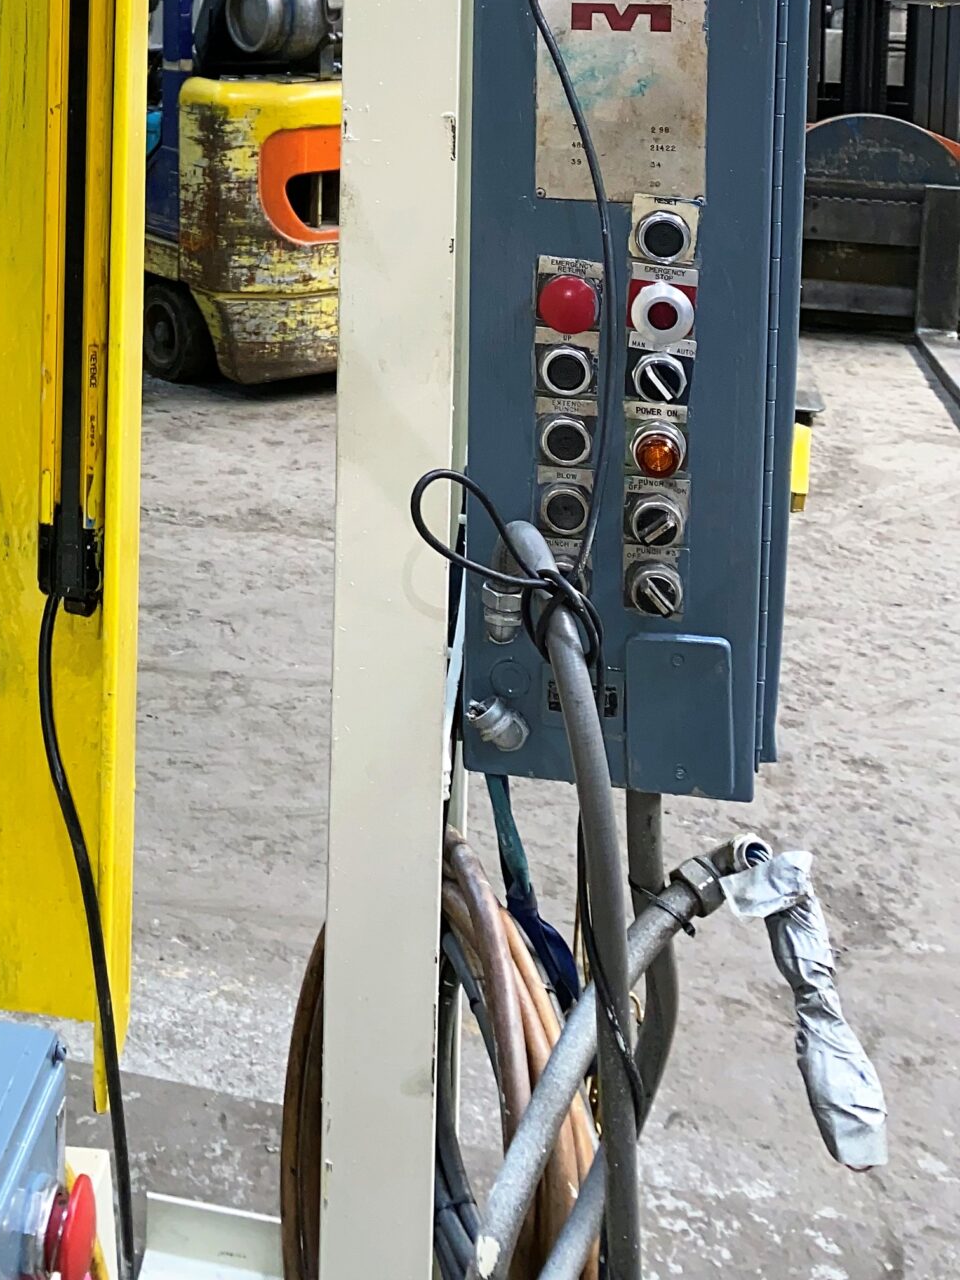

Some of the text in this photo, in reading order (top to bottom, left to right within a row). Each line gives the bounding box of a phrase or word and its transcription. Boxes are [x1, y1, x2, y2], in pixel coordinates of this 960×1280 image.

[650, 144, 677, 152] 21422
[551, 259, 594, 270] EMERGENCY
[558, 266, 587, 275] RETURN
[645, 266, 687, 277] EMERGENCY
[631, 340, 646, 348] MAN
[676, 348, 695, 357] AUTO
[635, 406, 678, 418] POWER ON
[556, 471, 577, 480] BLOW
[639, 479, 665, 488] PUNCH
[636, 547, 662, 555] PUNCH
